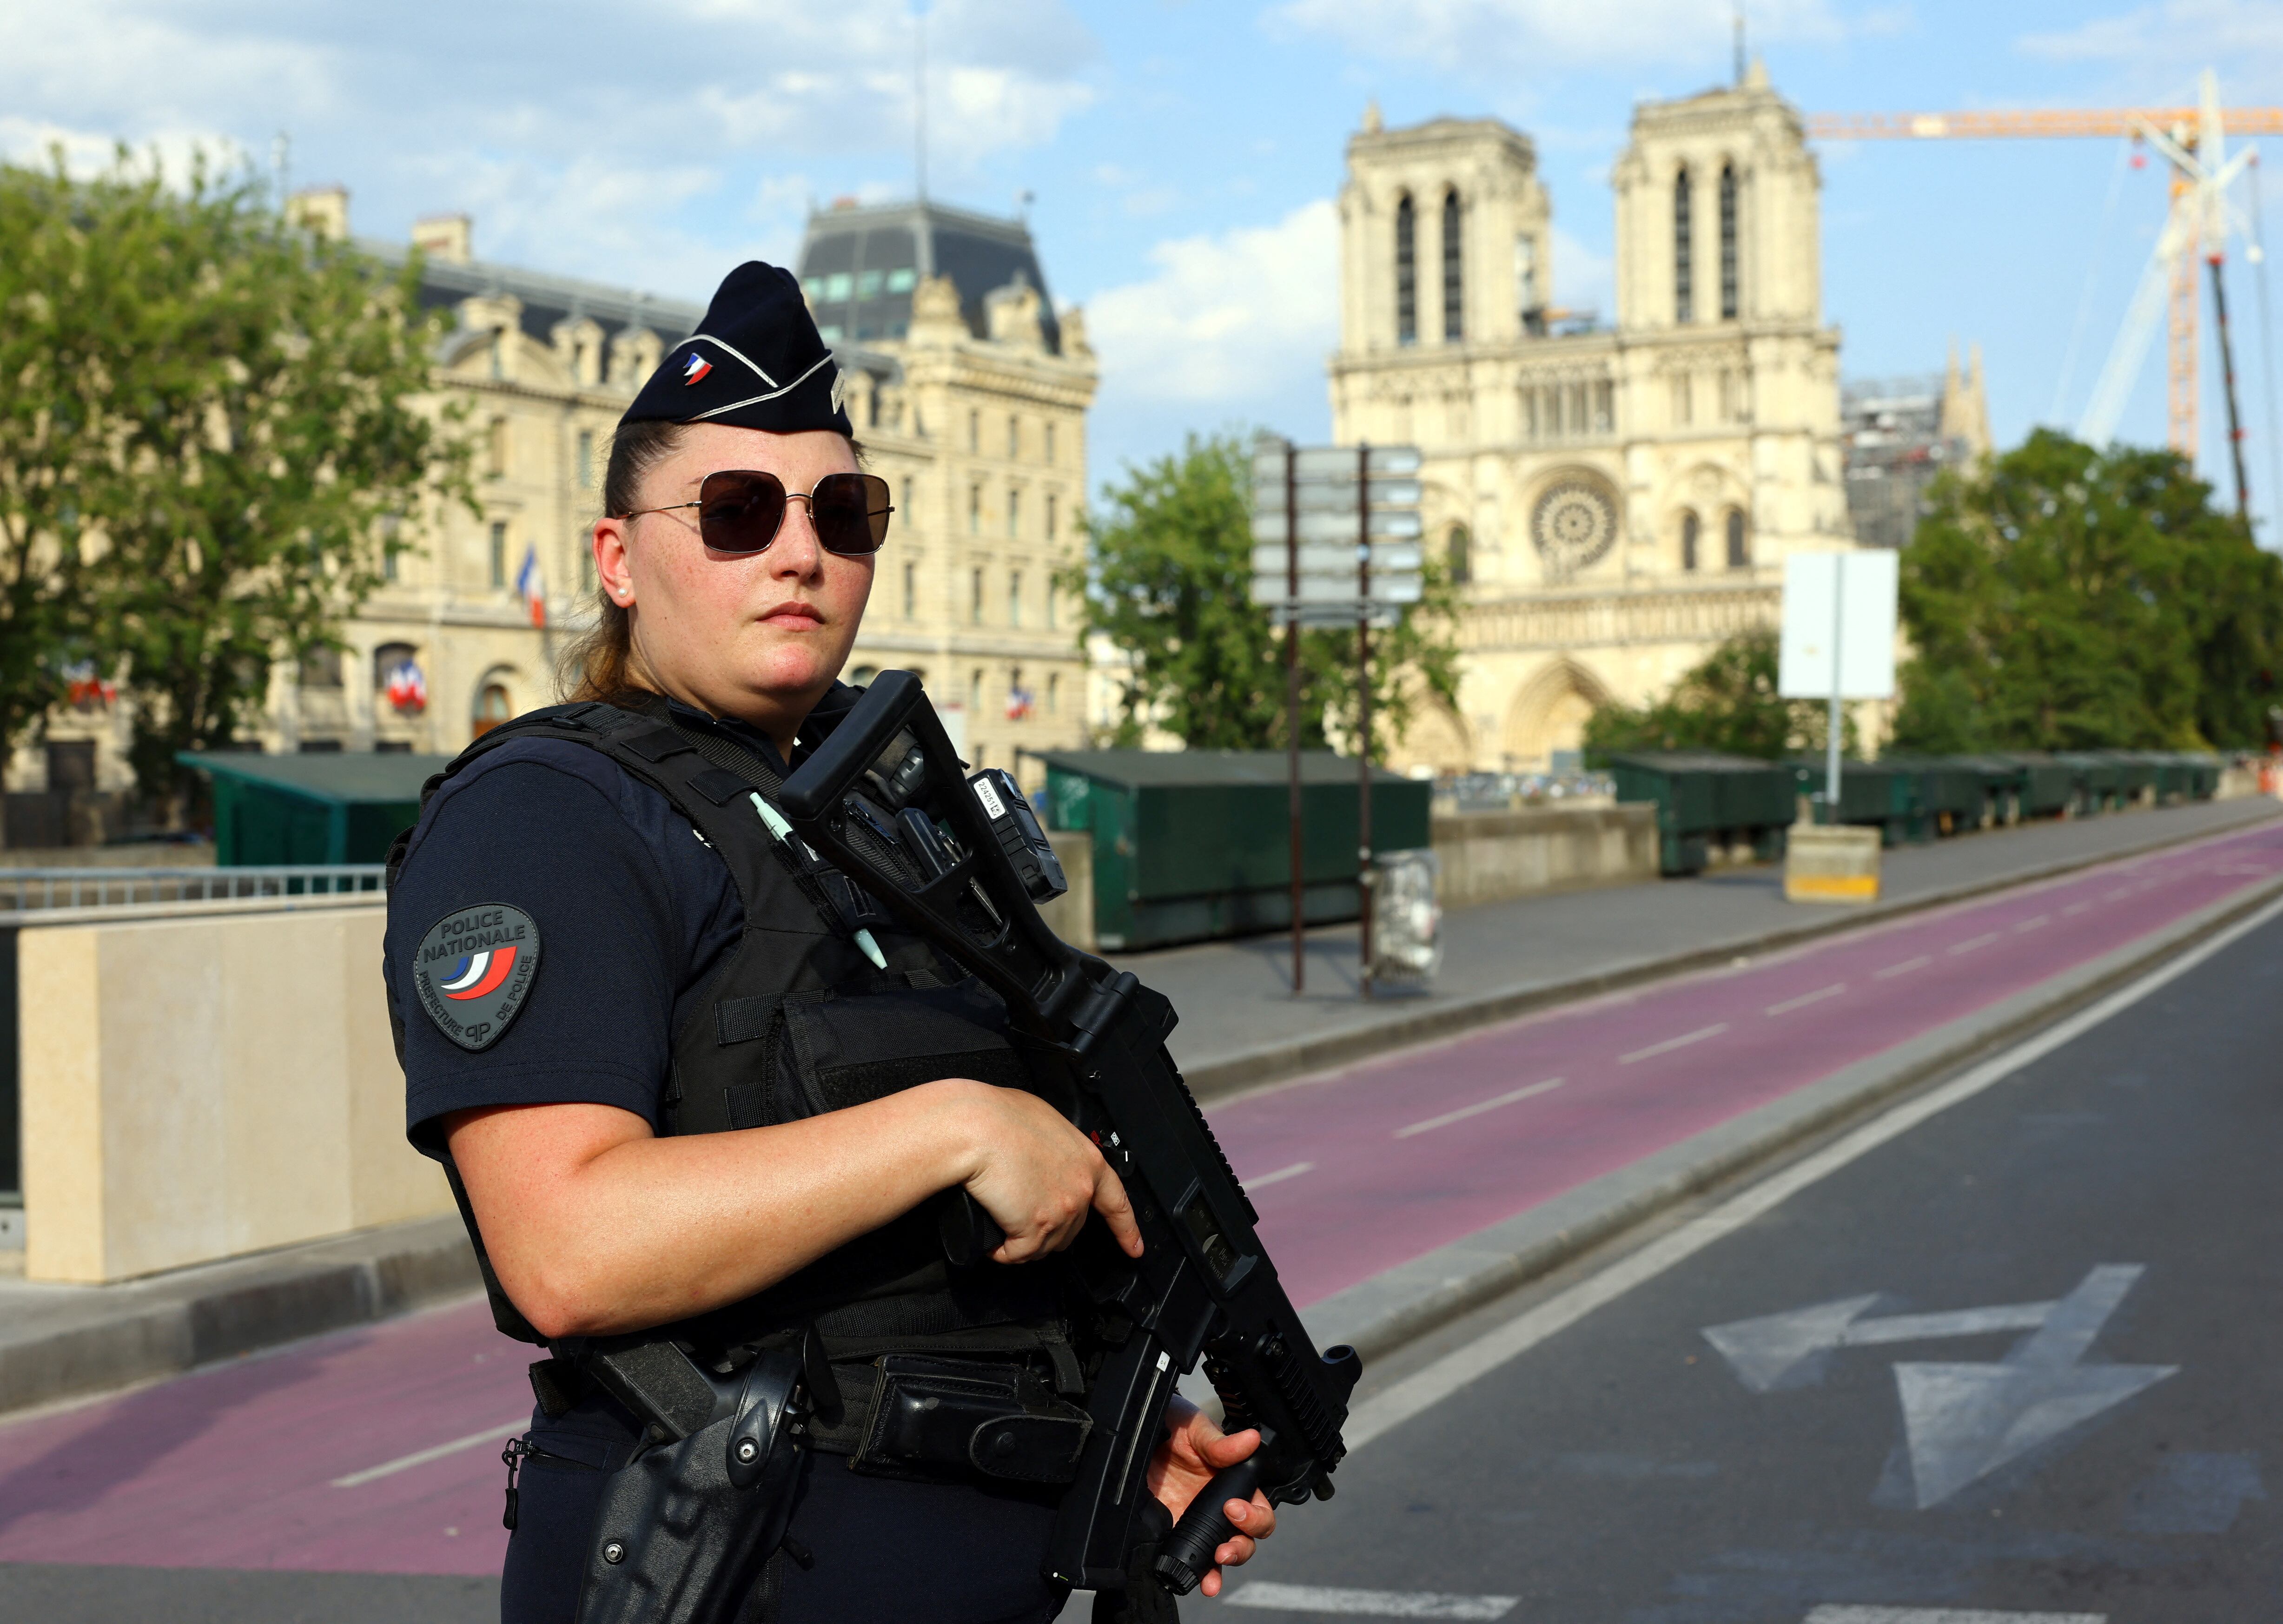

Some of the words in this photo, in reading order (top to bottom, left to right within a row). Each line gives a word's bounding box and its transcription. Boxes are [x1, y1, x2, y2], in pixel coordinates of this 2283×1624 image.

[979, 782, 995, 805] 224251
[424, 924, 525, 963] NATIONALE
[441, 910, 503, 939] POLICE
[419, 970, 463, 1036] PREFECTURE
[496, 1002, 512, 1021] DE
[508, 955, 532, 1001] POLICE
